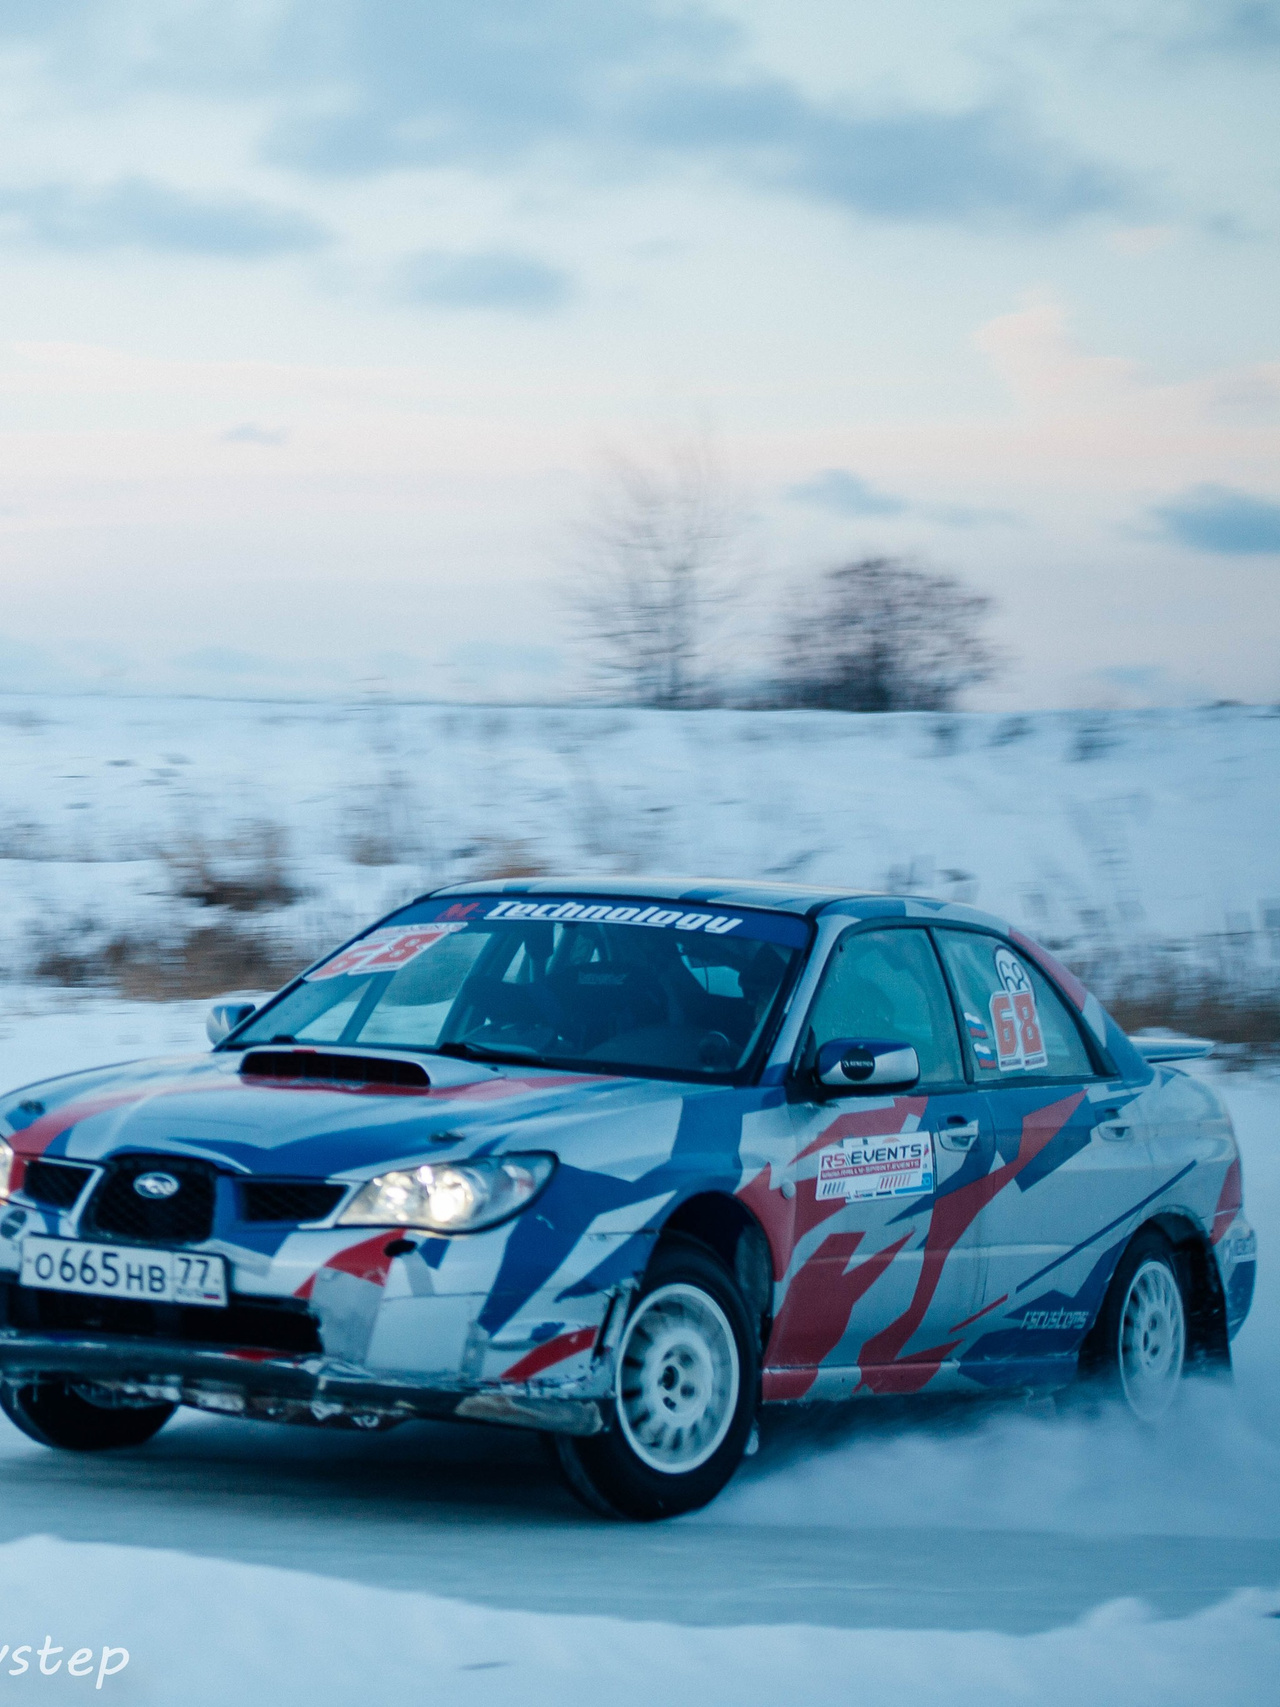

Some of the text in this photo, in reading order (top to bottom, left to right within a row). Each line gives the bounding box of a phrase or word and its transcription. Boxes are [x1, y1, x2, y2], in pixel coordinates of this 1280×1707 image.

[484, 901, 743, 934] Technology
[991, 991, 1045, 1058] 68
[851, 1144, 922, 1165] EVENTS
[178, 1257, 211, 1288] 77
